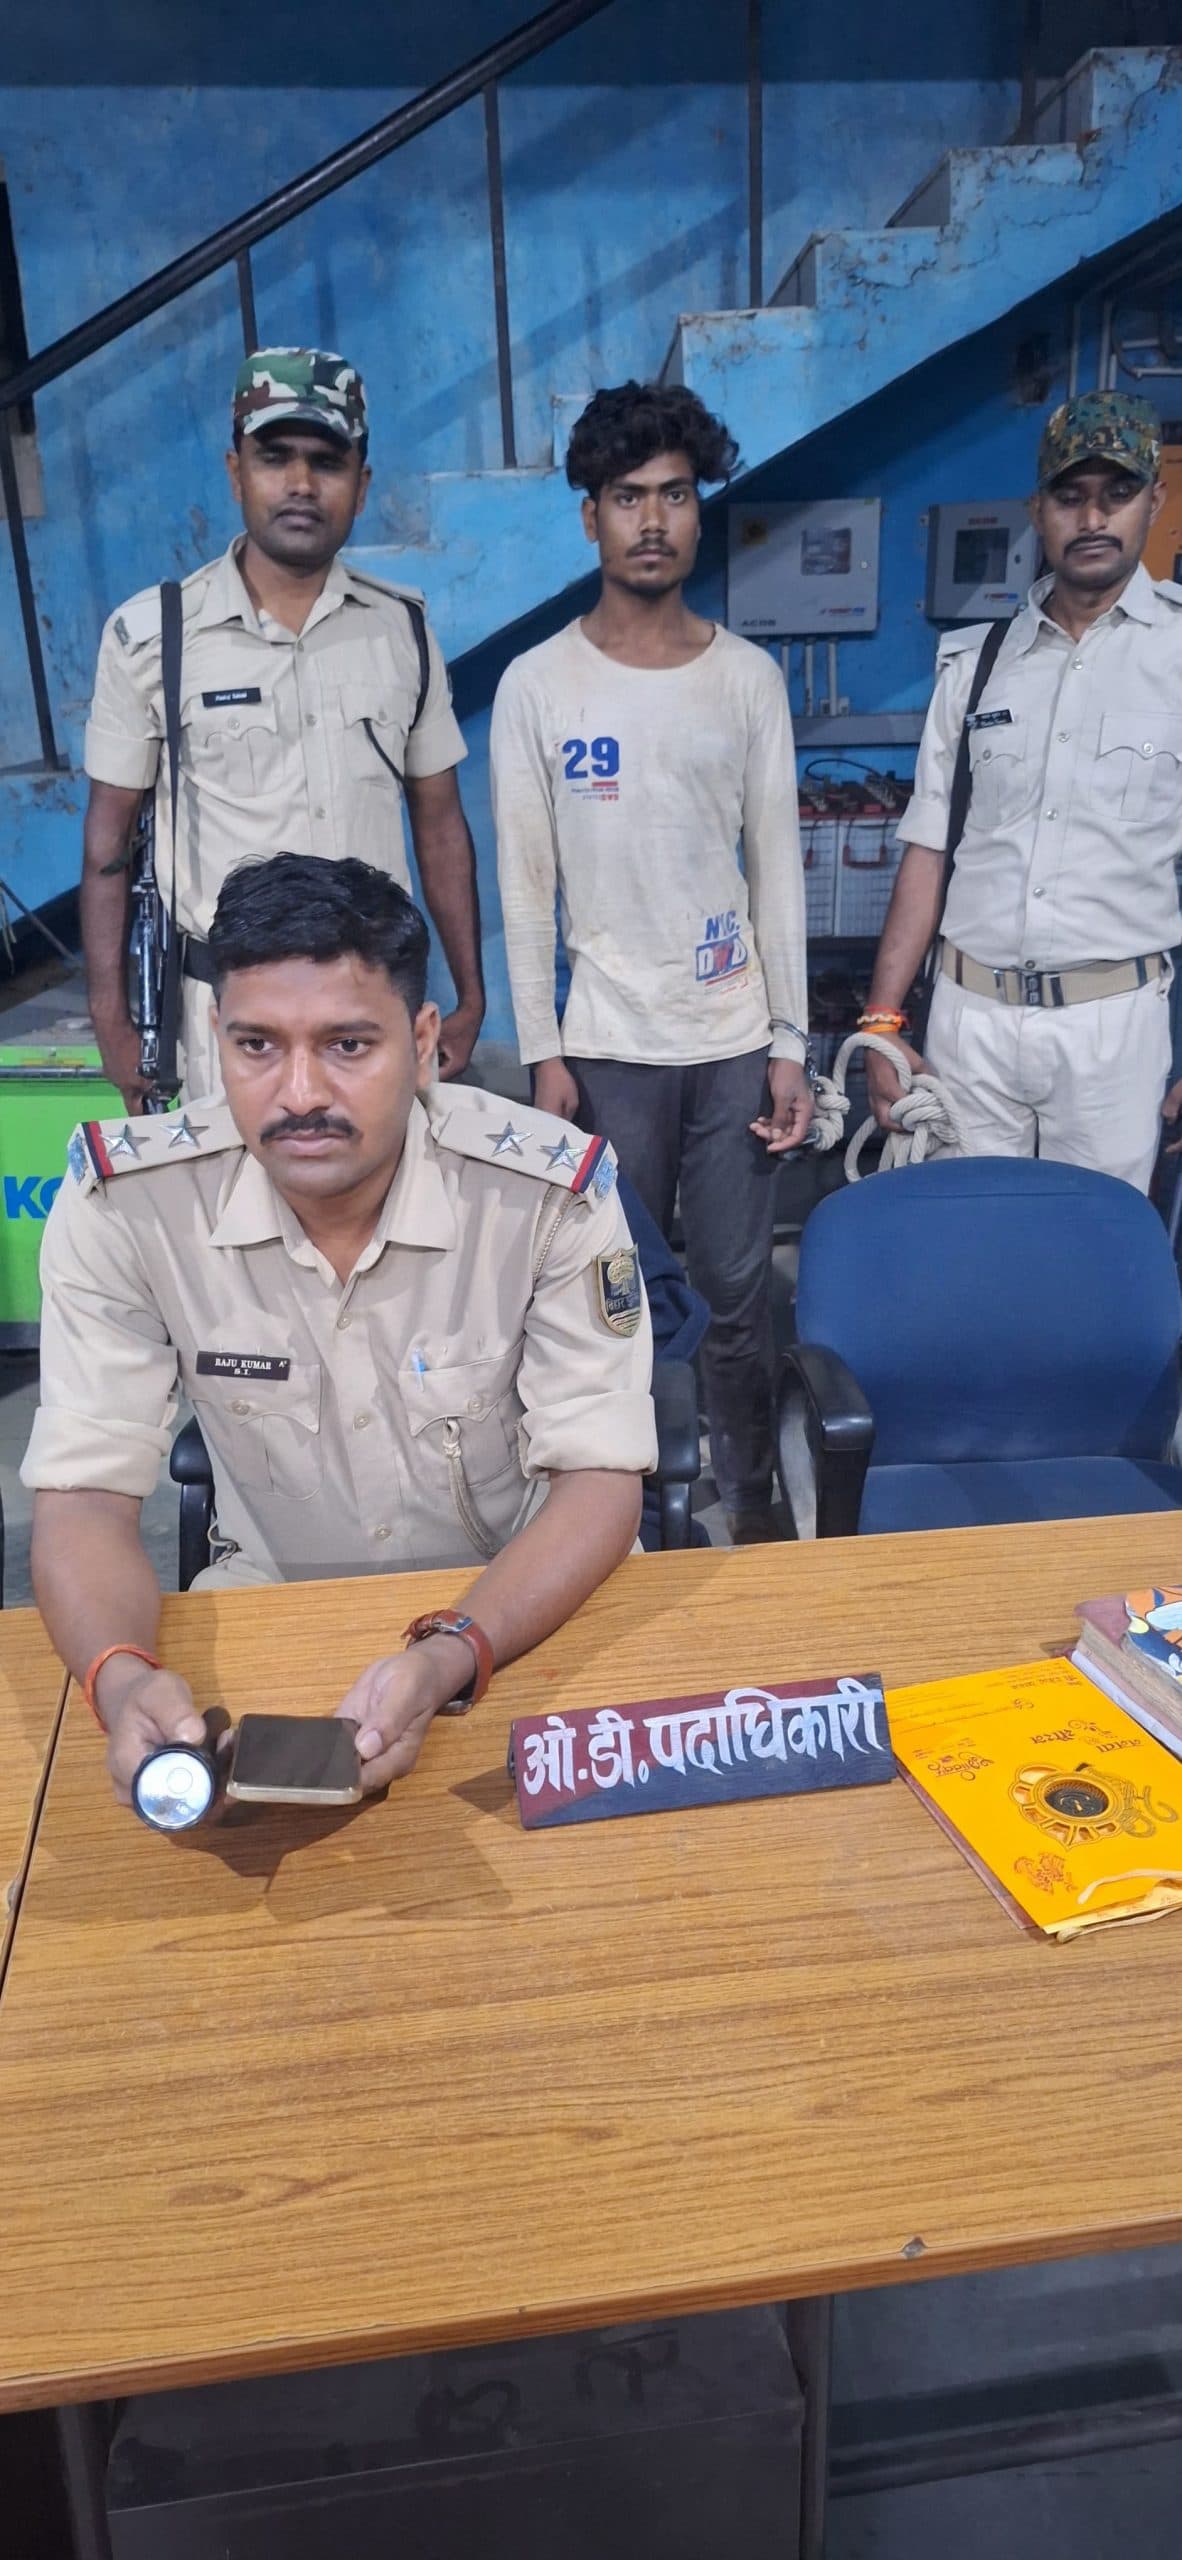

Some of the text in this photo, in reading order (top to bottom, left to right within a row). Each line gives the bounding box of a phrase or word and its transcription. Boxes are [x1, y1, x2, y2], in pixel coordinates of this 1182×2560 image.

[562, 736, 619, 779] 29
[214, 1357, 238, 1367] RAJU
[240, 1359, 272, 1370] KUMAR
